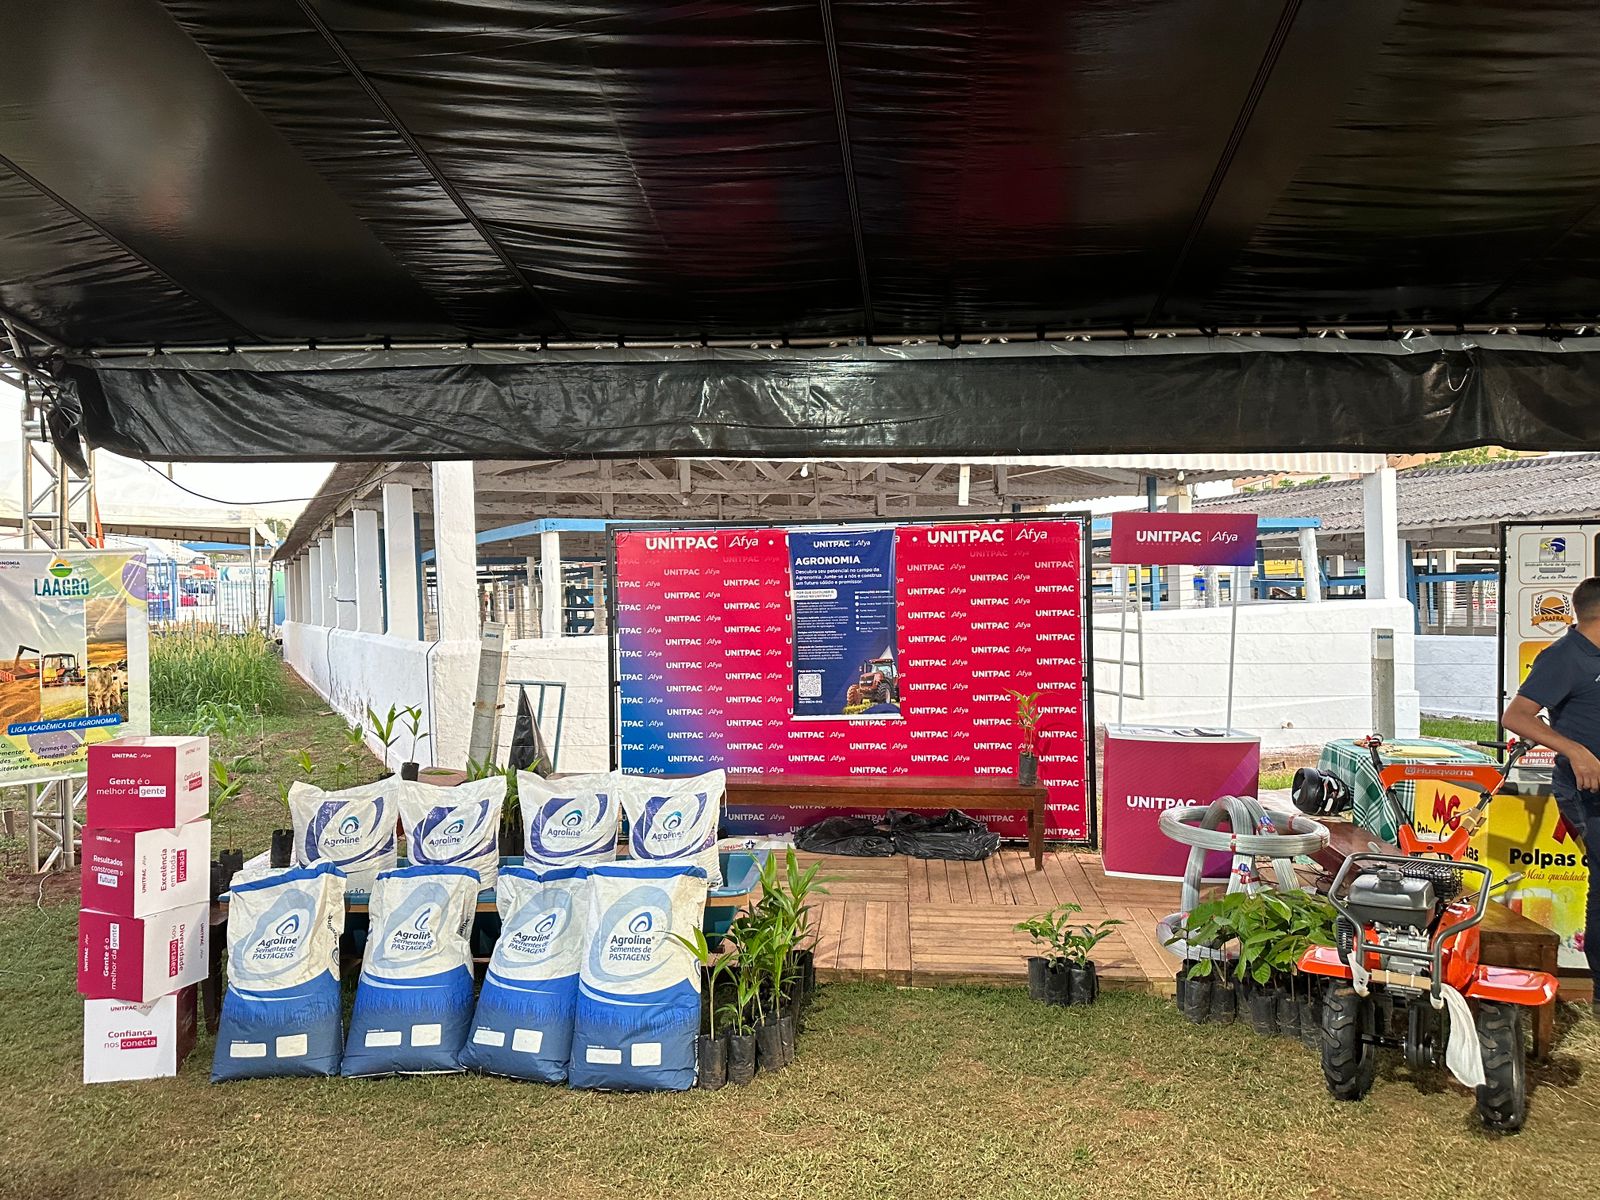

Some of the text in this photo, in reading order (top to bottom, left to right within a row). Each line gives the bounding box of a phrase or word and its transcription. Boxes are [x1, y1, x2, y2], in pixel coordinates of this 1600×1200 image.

[928, 529, 1047, 544] UNITPAC Afya
[1136, 531, 1238, 544] UNITPAC Afya
[646, 536, 758, 550] UNITPAC Afya
[813, 540, 850, 548] UNITPAC
[795, 556, 861, 566] AGRONOMIA
[663, 568, 721, 576] UNITPAC Afya
[906, 563, 966, 572] UNITPAC Afya
[969, 573, 1031, 582] UNITPAC Afya
[34, 578, 90, 596] LAAGRO
[723, 578, 781, 587] UNITPAC Afya
[664, 614, 722, 623] UNITPAC Afya
[907, 610, 967, 619] UNITPAC Afya
[724, 625, 782, 634] UNITPAC Afya
[970, 621, 1032, 630] UNITPAC Afya
[665, 661, 723, 670] UNITPAC Afya
[908, 658, 969, 667] UNITPAC Afya
[725, 672, 783, 681] UNITPAC Afya
[971, 669, 1033, 678] UNITPAC Afya
[10, 726, 27, 734] LIGA
[28, 721, 66, 732] ACADÊMICA
[77, 717, 117, 727] AGRONOMIA
[787, 731, 846, 739] UNITPAC Afya
[849, 742, 908, 751] UNITPAC Afya
[667, 755, 724, 763] UNITPAC Afya
[910, 754, 971, 763] UNITPAC Afya
[727, 766, 785, 775] UNITPAC Afya
[1416, 768, 1474, 778] Husqvarna
[137, 777, 143, 785] é
[96, 787, 165, 797] melhor da gente
[547, 827, 580, 838] Agroline
[323, 834, 361, 847] Agroline
[429, 834, 462, 847] Agroline
[93, 855, 123, 867] Resultados
[1509, 849, 1576, 870] Polpas
[91, 865, 119, 876] constroem
[99, 875, 116, 886] futuro
[170, 875, 176, 887] em
[1523, 871, 1586, 882] Mais qualidade
[258, 936, 298, 950] Agroline
[611, 935, 651, 946] Agroline
[254, 946, 287, 954] Sementes
[609, 945, 651, 953] Sementes de
[111, 950, 117, 960] da
[252, 951, 294, 960] PASTAGENS
[609, 953, 651, 961] PASTAGENS
[108, 1030, 152, 1039] Confiança
[122, 1038, 156, 1048] conecta
